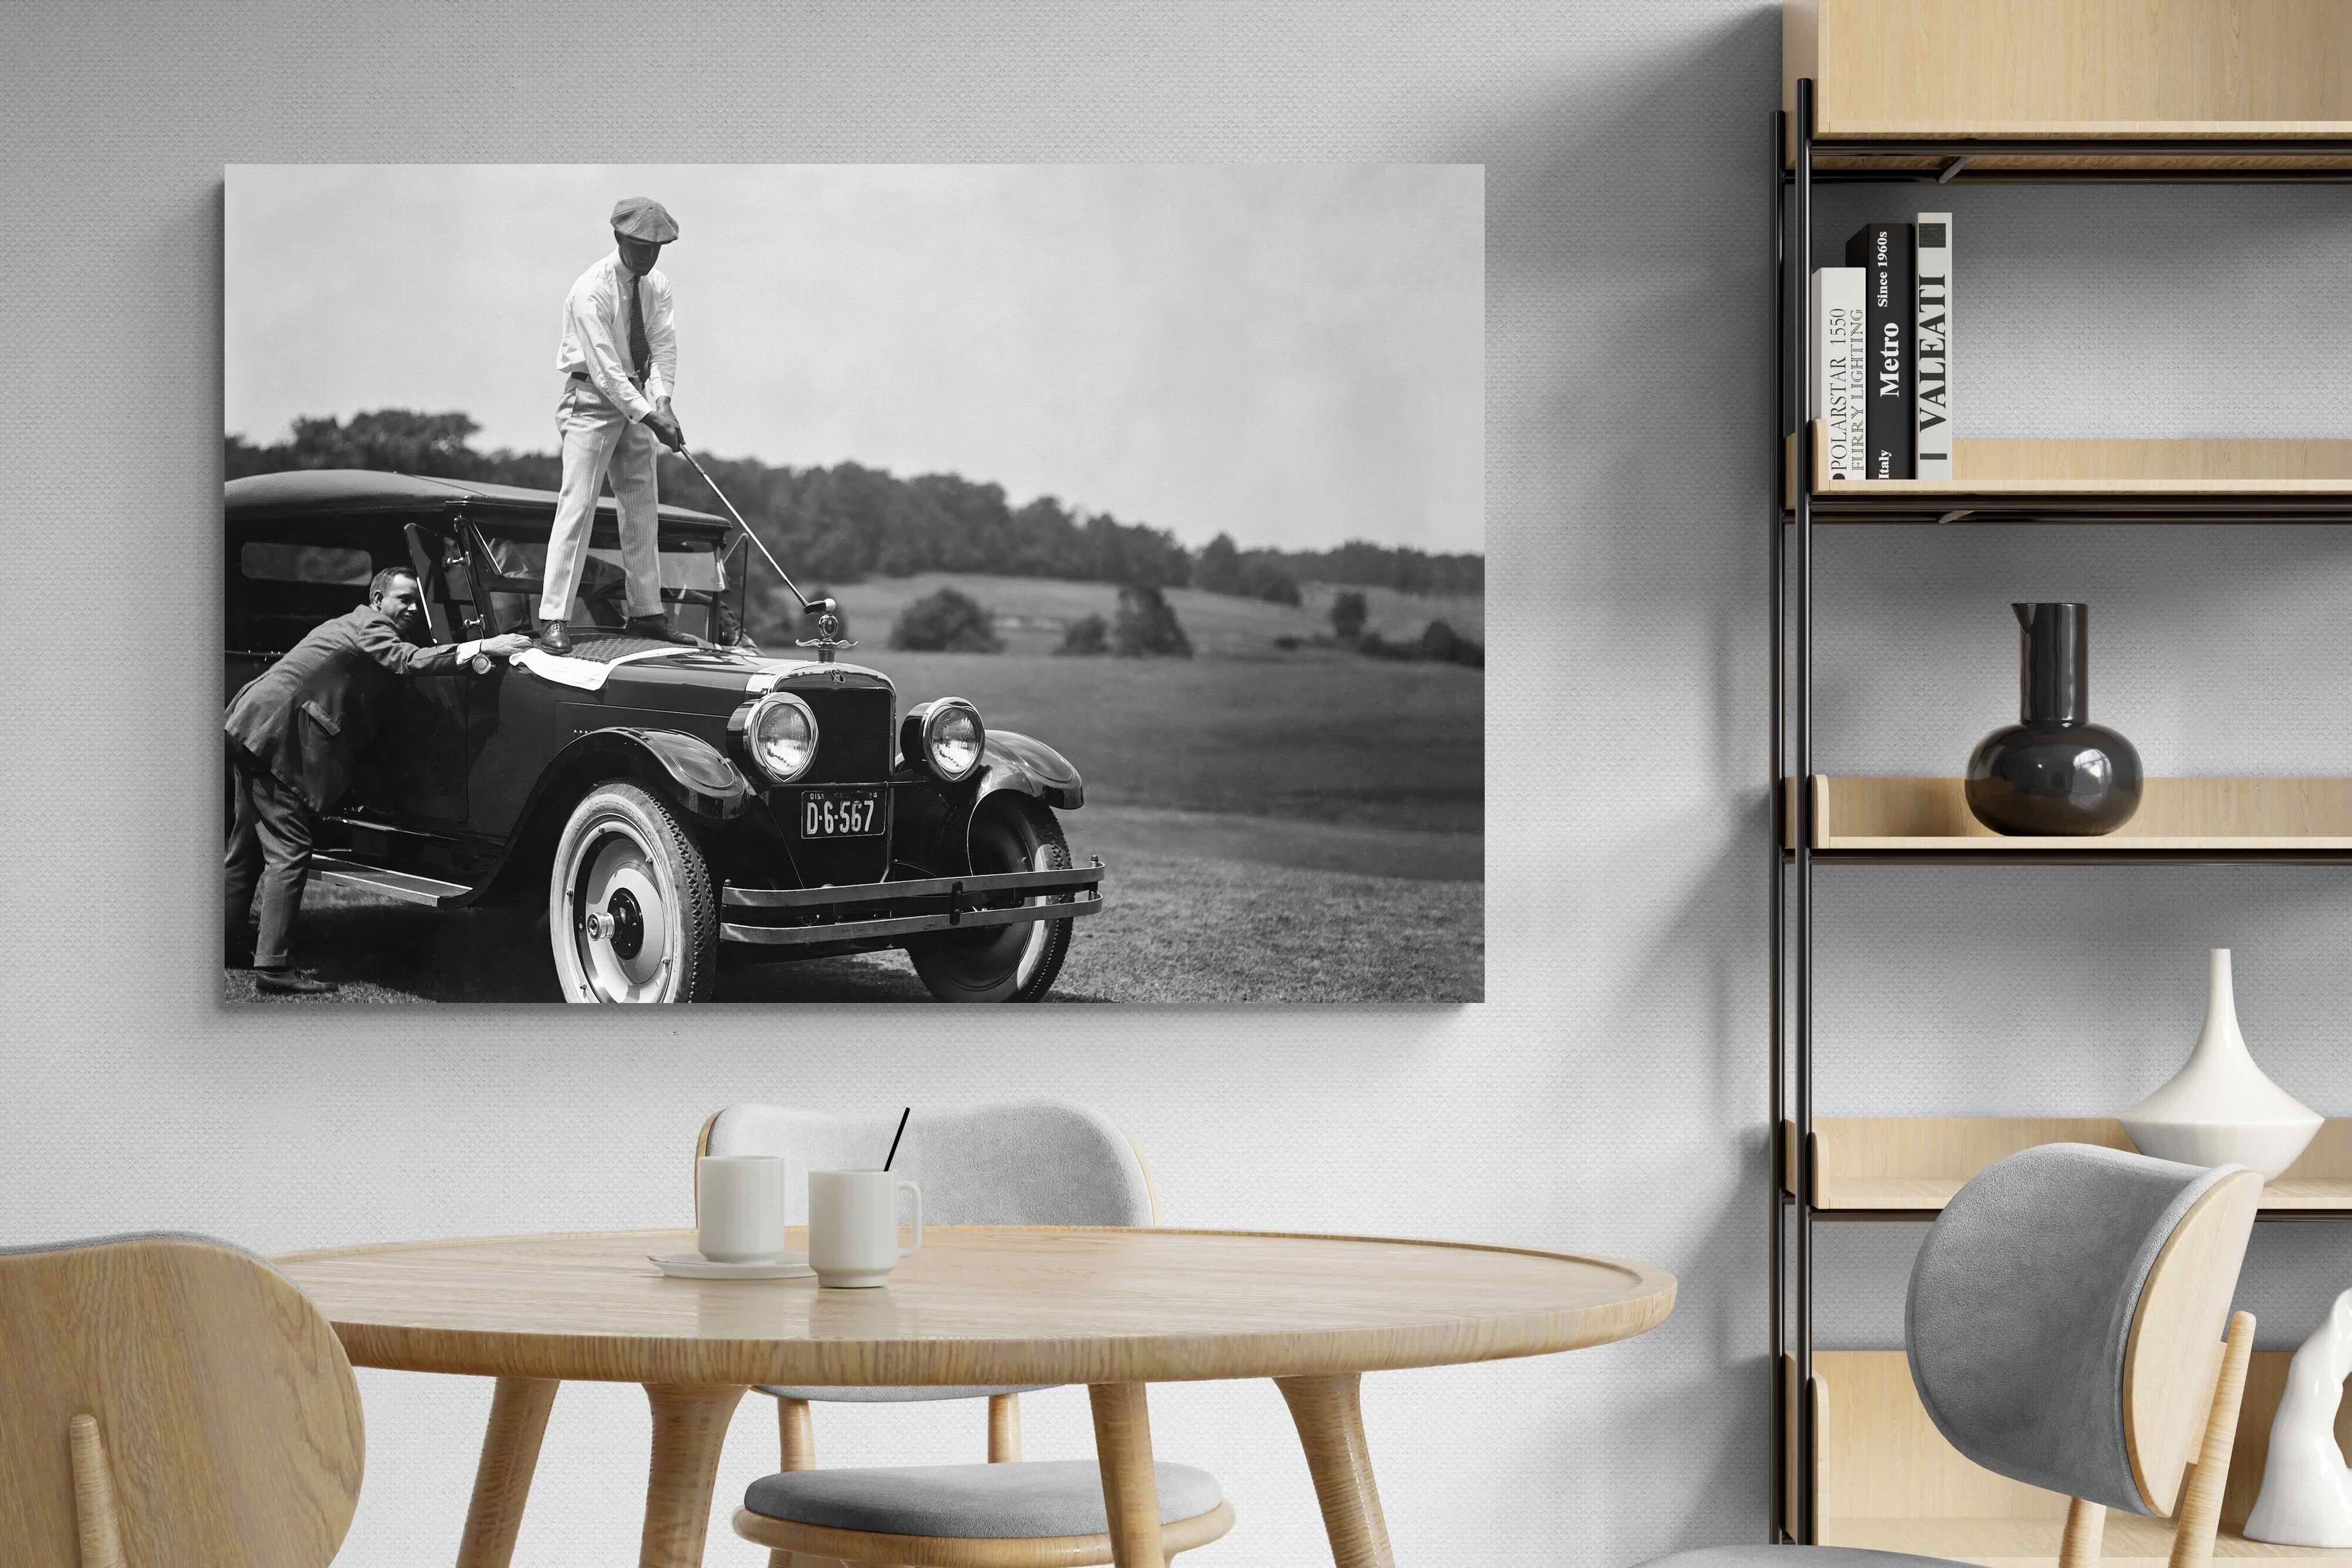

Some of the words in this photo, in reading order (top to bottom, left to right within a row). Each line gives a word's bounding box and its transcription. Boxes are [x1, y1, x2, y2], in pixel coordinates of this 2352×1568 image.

[1876, 231, 1887, 268] 1960s
[1876, 272, 1888, 307] Since
[1829, 309, 1846, 345] 1550
[1850, 309, 1863, 400] LIGHTING
[1879, 322, 1899, 397] Metro
[1919, 274, 1946, 433] VALEATI
[1829, 356, 1847, 471] POLARSTAR
[1851, 405, 1864, 471] FURRY
[1878, 449, 1892, 480] Italy
